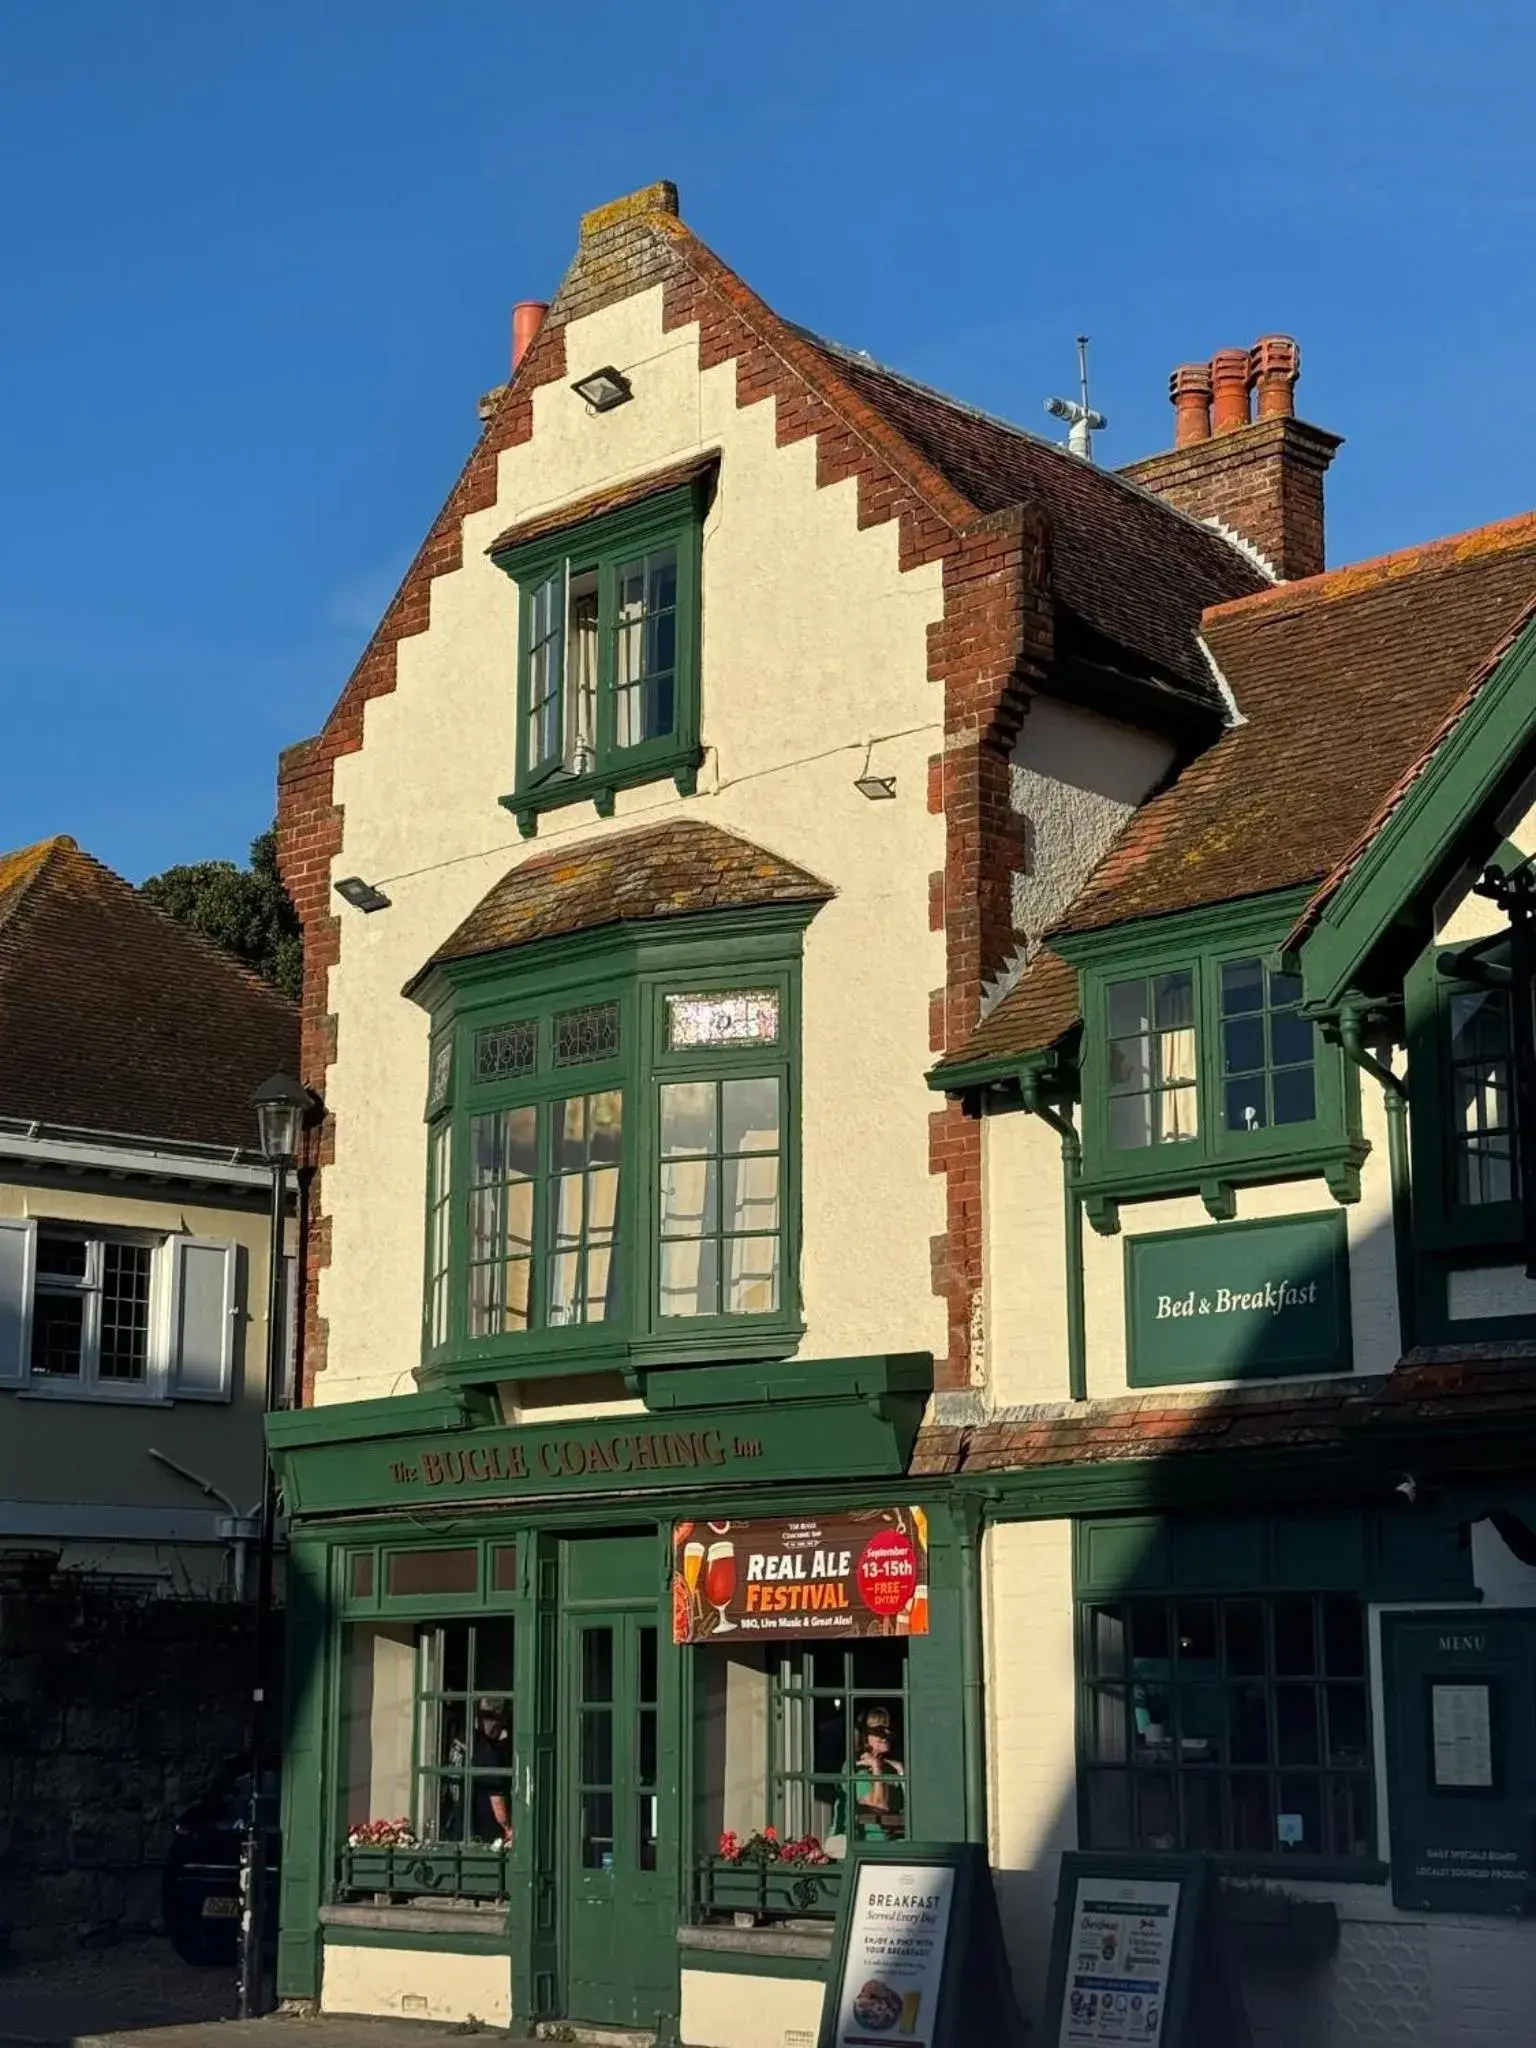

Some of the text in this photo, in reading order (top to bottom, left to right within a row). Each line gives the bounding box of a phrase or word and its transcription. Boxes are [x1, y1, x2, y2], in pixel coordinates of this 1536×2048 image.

[1155, 1279, 1319, 1319] Bed & Breakfast
[389, 1430, 763, 1486] The BUGLE COACHING Inn
[867, 1546, 909, 1559] September
[746, 1550, 852, 1581] REAL ALE
[862, 1560, 913, 1579] 13-15th
[874, 1582, 900, 1595] FREE
[746, 1583, 849, 1612] FESTIVAL
[761, 1618, 777, 1629] Live
[778, 1617, 802, 1628] Music
[803, 1616, 810, 1627] &
[811, 1616, 834, 1627] Great
[1437, 1633, 1486, 1652] MENU
[869, 1893, 941, 1909] BREAKFAST
[864, 1936, 887, 1946] ENJOY
[865, 1946, 885, 1955] YOUR
